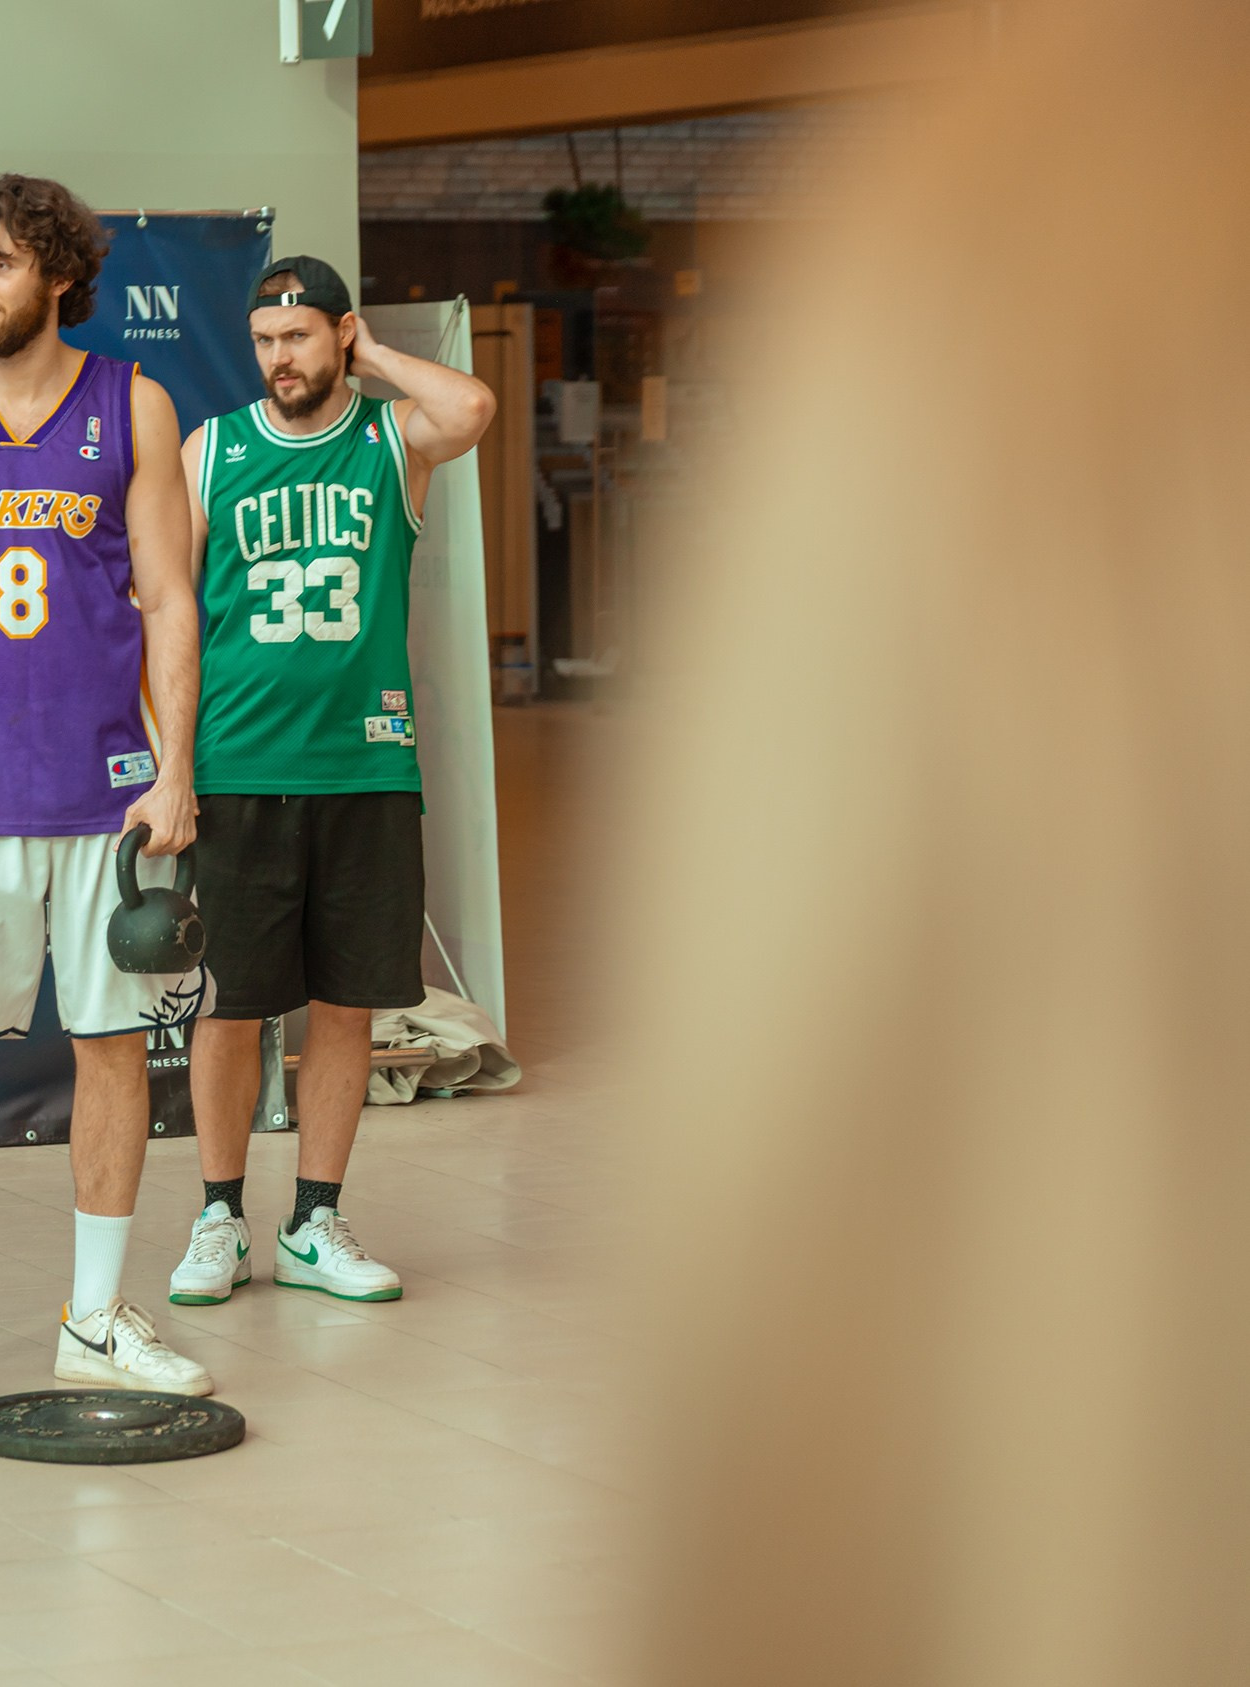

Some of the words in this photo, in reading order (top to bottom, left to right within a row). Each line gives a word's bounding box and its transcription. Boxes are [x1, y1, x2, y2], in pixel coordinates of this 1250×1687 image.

[126, 286, 179, 320] NN
[124, 329, 180, 339] FITNESS
[234, 482, 374, 563] CELTICS
[247, 556, 361, 643] 33
